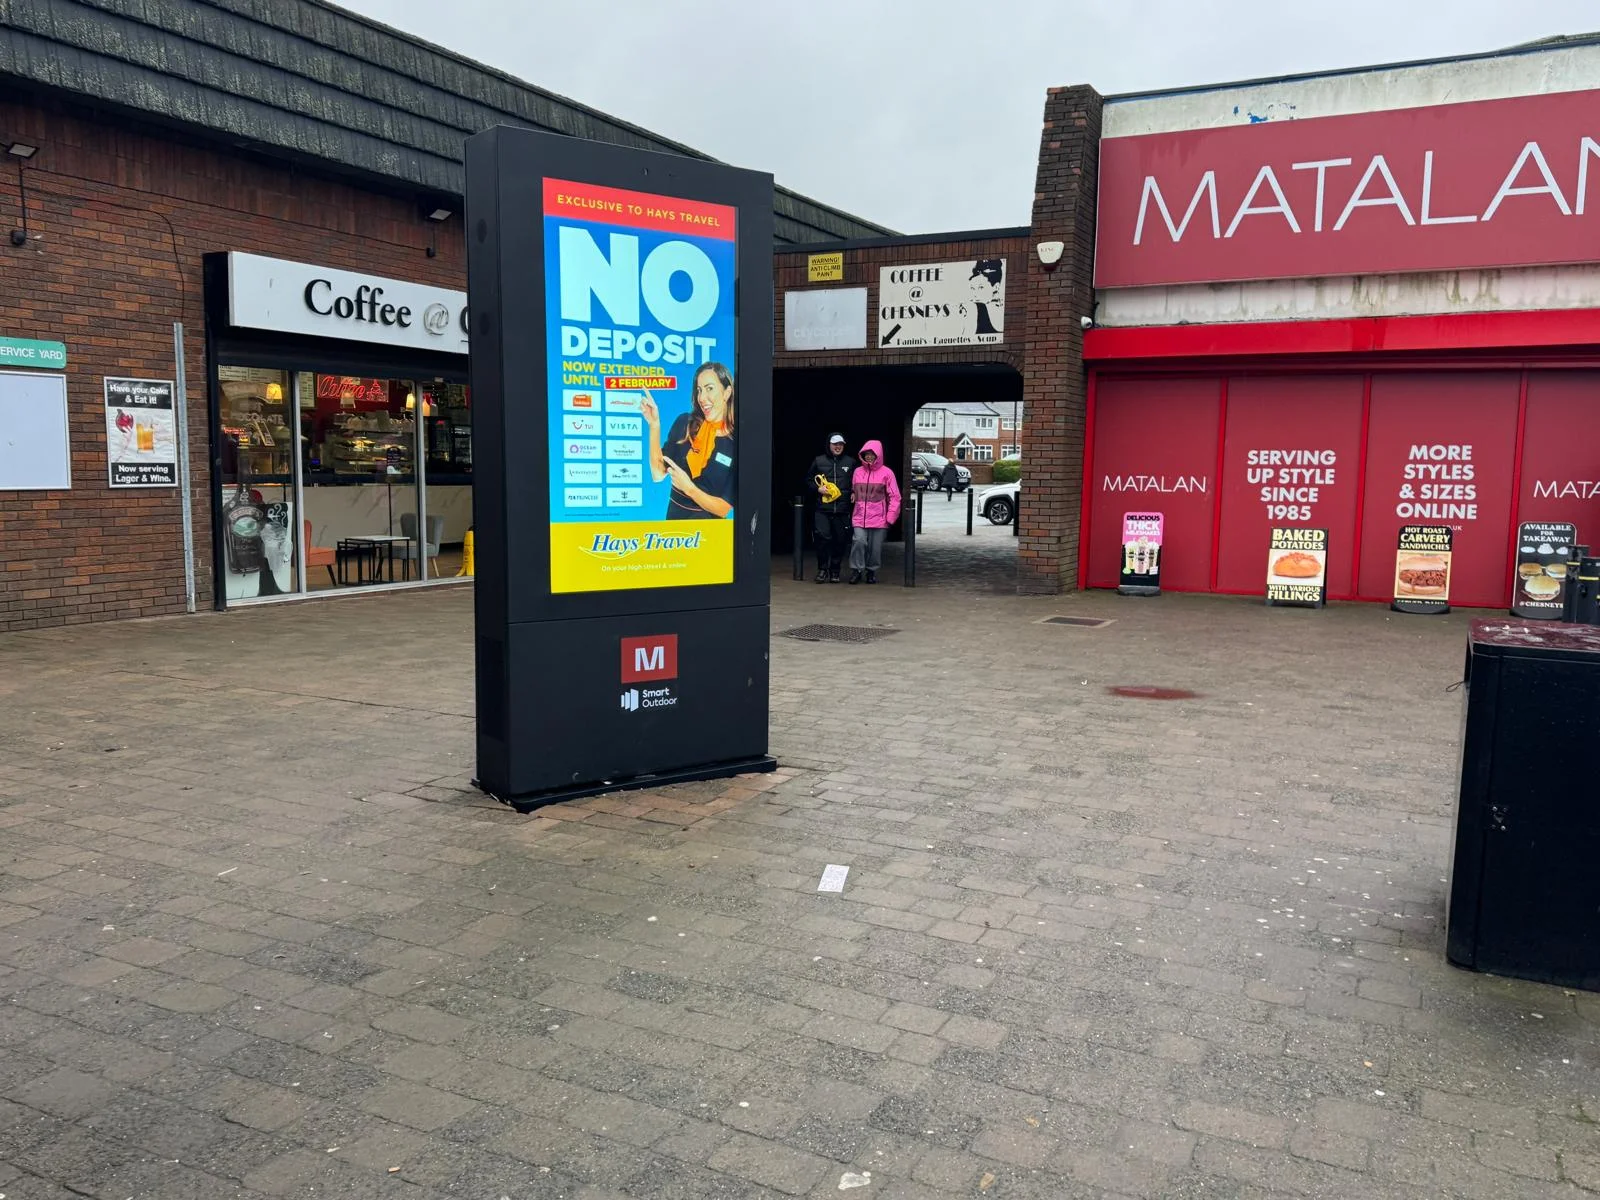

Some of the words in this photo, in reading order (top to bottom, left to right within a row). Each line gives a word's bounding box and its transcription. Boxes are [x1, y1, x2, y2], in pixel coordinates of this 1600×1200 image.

[557, 194, 623, 213] EXCLUSIVE
[627, 204, 643, 215] TO
[647, 208, 676, 220] HAYS
[680, 212, 721, 227] TRAVEL
[811, 257, 840, 265] WARNING!
[559, 226, 720, 332] NO
[890, 268, 944, 285] COFFEE
[908, 286, 924, 302] @
[304, 278, 412, 328] Coffee
[423, 303, 449, 336] @
[881, 304, 950, 320] CHESNEYS
[561, 325, 717, 365] DEPOSIT
[0, 346, 35, 358] ERVICE
[39, 349, 63, 360] YARD
[562, 360, 595, 373] NOW
[599, 363, 665, 377] EXTENDED
[563, 373, 601, 387] UNTIL
[610, 379, 617, 388] 2
[618, 379, 672, 388] FEBRUARY
[110, 384, 130, 392] Have
[150, 387, 169, 395] Cake
[125, 395, 132, 403] &
[134, 395, 147, 404] Eat
[610, 423, 638, 431] VISTA
[1247, 449, 1336, 465] SERVING
[1408, 444, 1472, 460] MORE
[139, 465, 168, 474] serving
[1247, 468, 1274, 484] UP
[1279, 468, 1335, 484] STYLE
[1403, 464, 1475, 480] STYLES
[116, 474, 139, 483] Lager
[1103, 475, 1207, 493] MATALAN
[1260, 487, 1319, 502] SINCE
[1399, 483, 1415, 499] &
[1420, 484, 1476, 500] SIZES
[1533, 480, 1600, 498] MATA
[1266, 505, 1312, 520] 1985
[1396, 502, 1478, 519] ONLINE
[1127, 521, 1160, 530] THICK
[1524, 523, 1572, 531] AVAILABLE
[1272, 528, 1325, 541] BAKED
[1400, 533, 1450, 543] CARVERY
[1523, 535, 1571, 543] TAKEAWAY
[592, 534, 639, 555] Hays
[644, 531, 701, 550] Travel
[1271, 540, 1324, 550] POTATOES
[1400, 542, 1450, 550] SANDWICHES
[1267, 591, 1321, 602] FILLINGS
[635, 646, 664, 672] M
[642, 687, 670, 698] Smart
[641, 697, 678, 708] Outdoor
